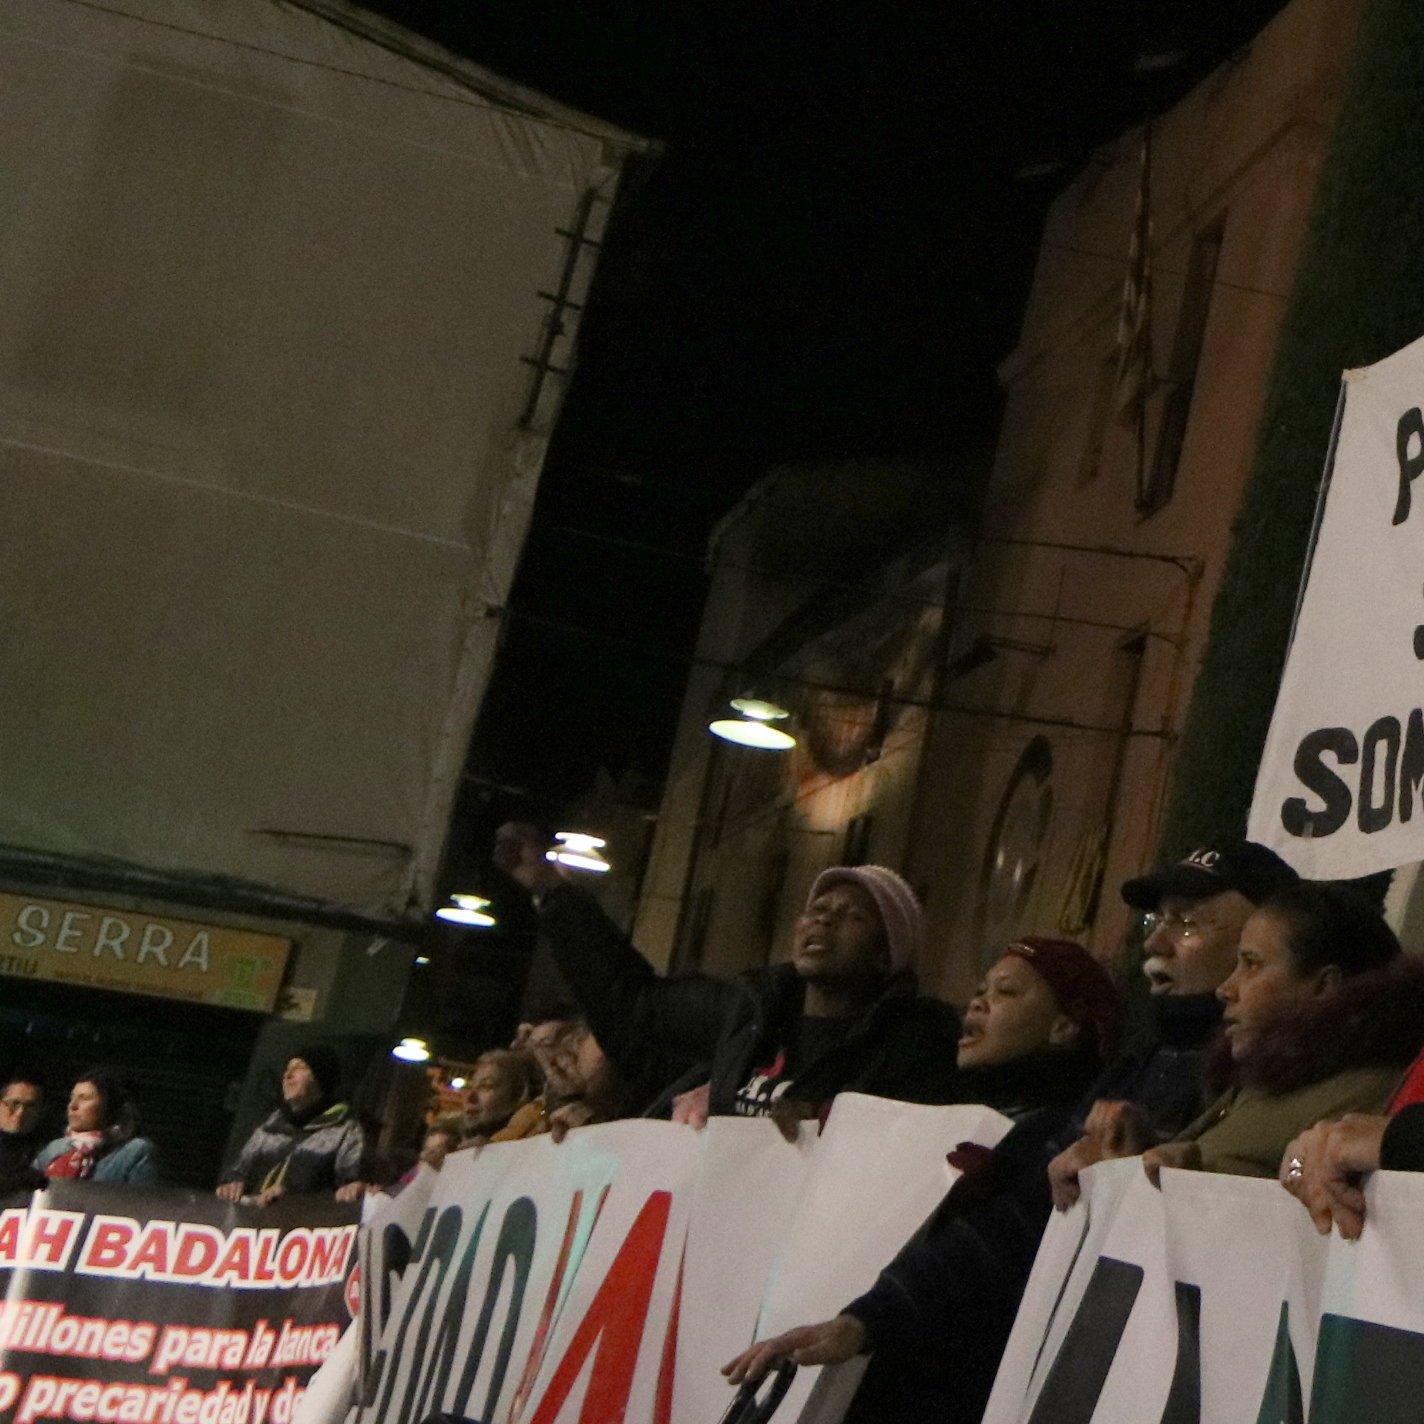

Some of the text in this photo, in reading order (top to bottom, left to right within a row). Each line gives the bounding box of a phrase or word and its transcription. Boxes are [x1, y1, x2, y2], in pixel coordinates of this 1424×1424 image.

[12, 904, 209, 973] SERRA
[80, 1219, 353, 1284] BADALONA
[152, 1327, 249, 1372] para
[245, 1320, 275, 1367] la
[14, 1377, 256, 1424] precariedad
